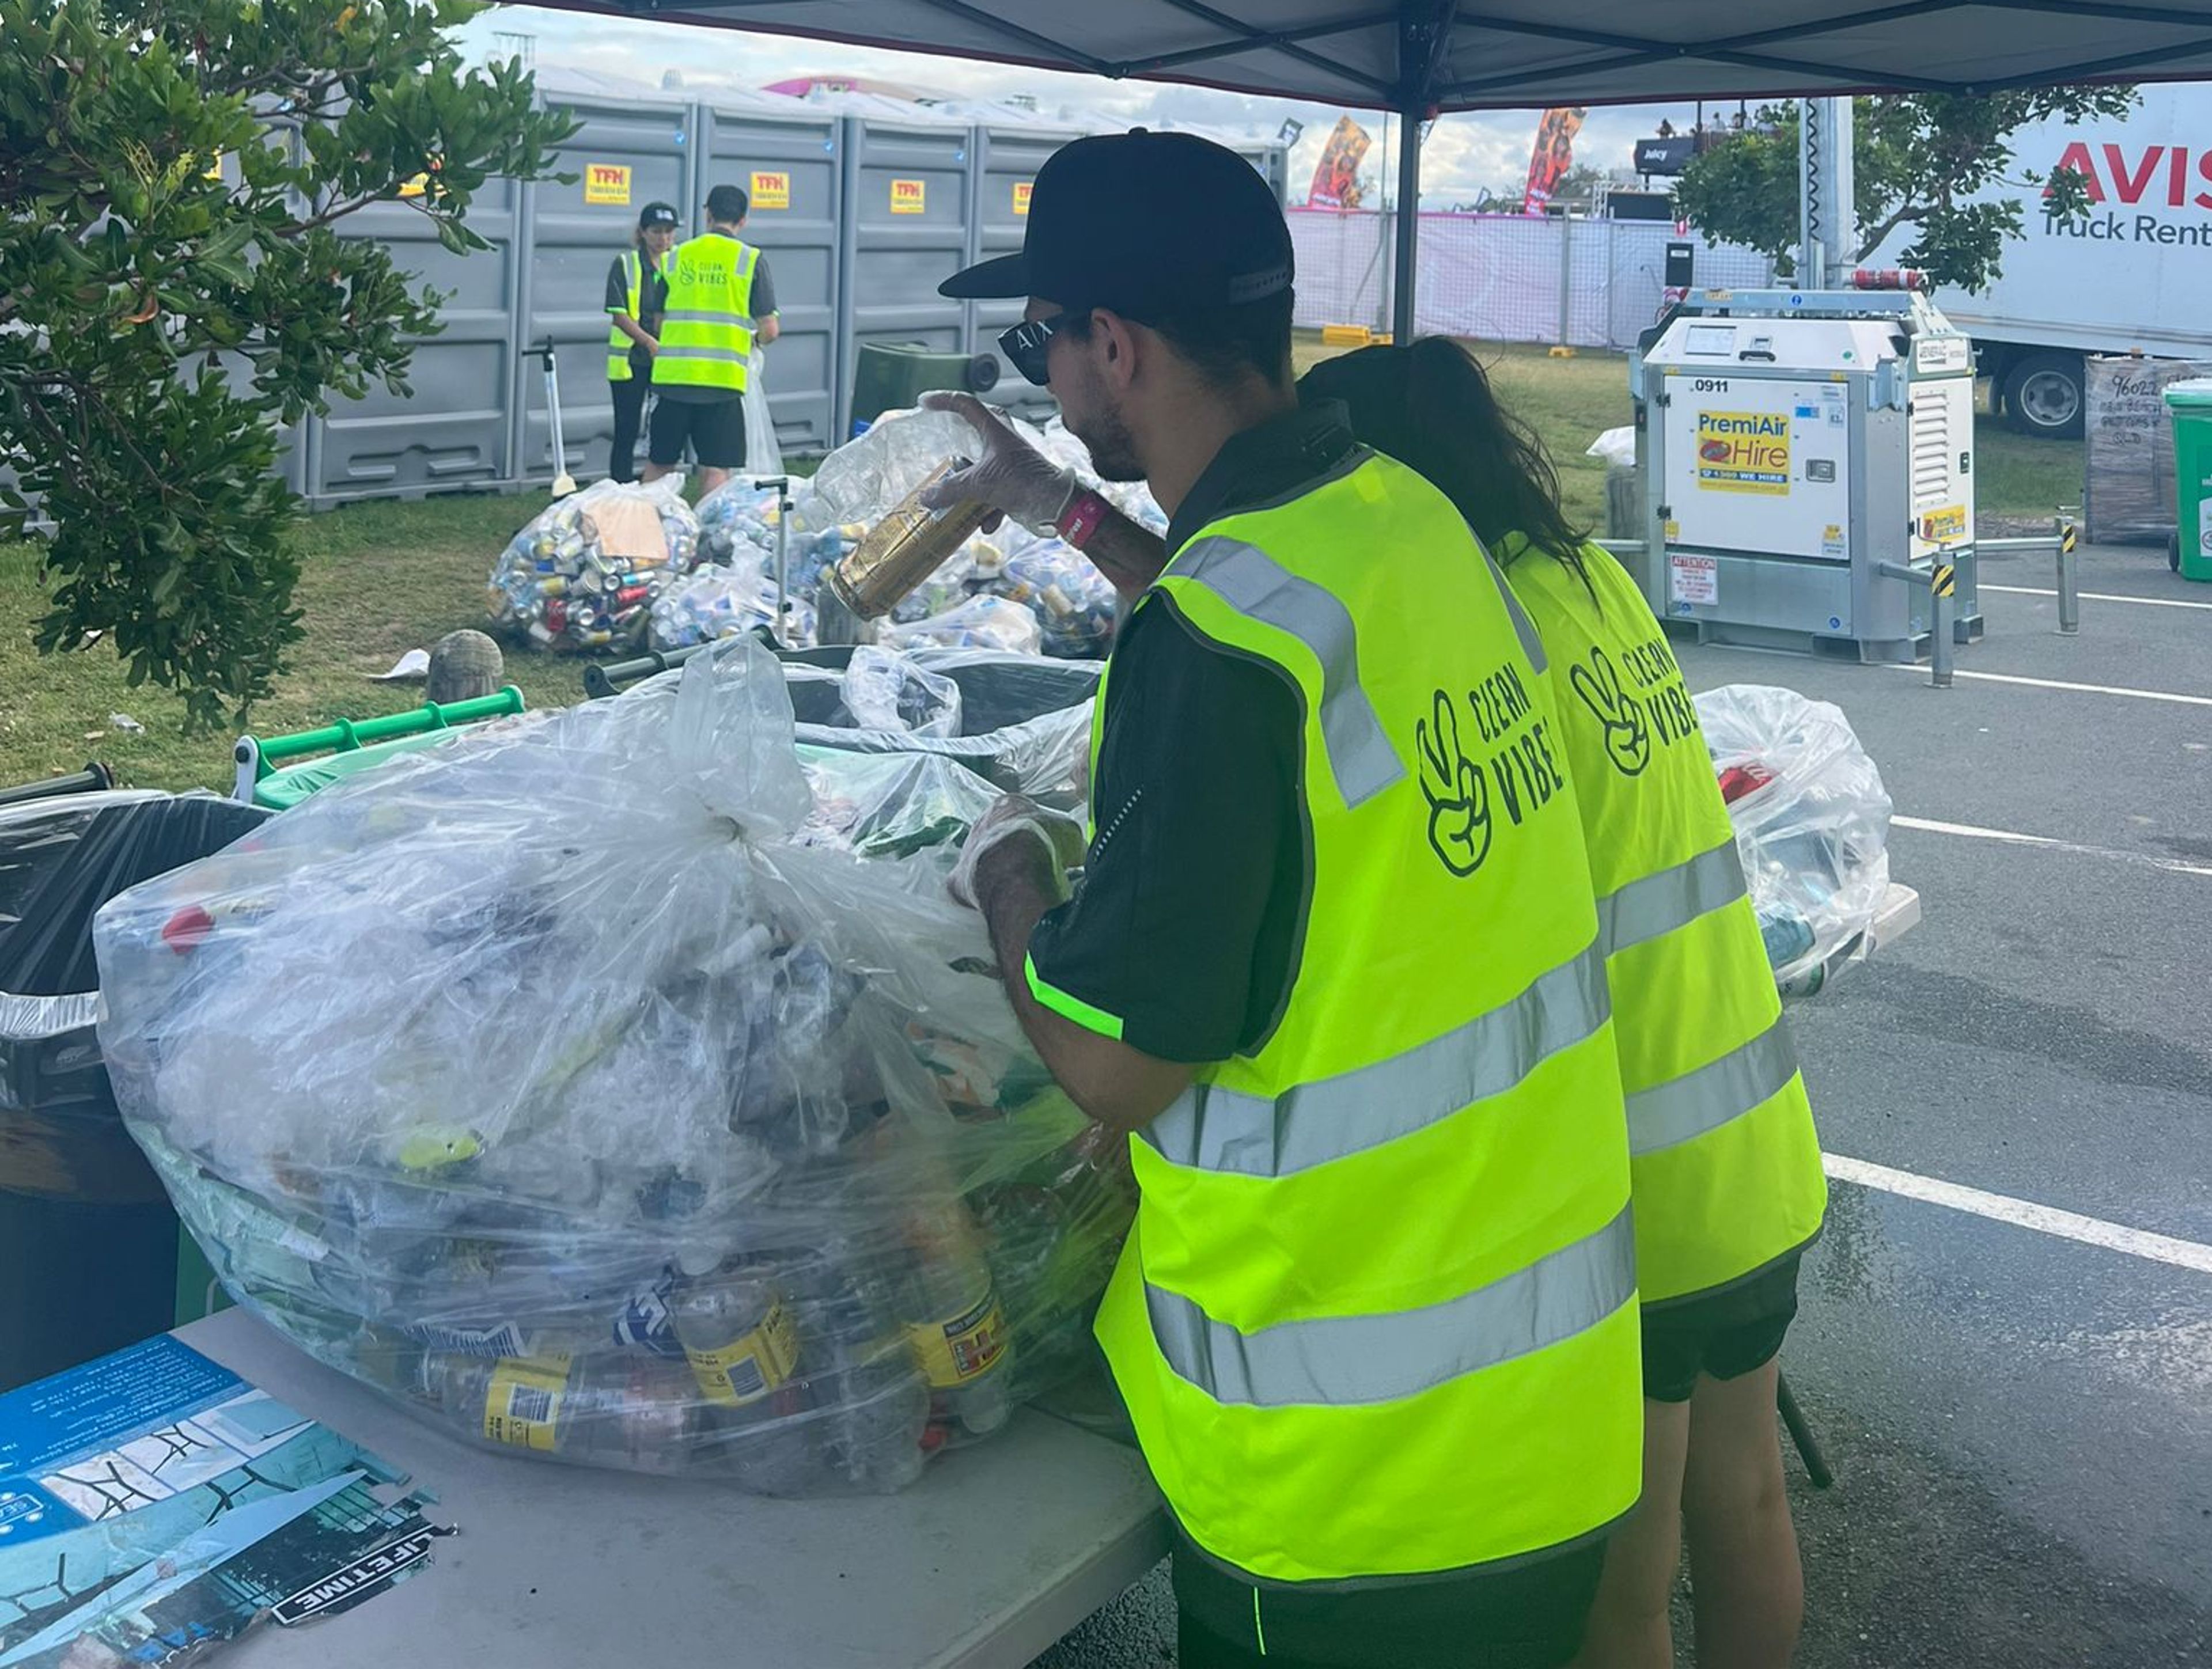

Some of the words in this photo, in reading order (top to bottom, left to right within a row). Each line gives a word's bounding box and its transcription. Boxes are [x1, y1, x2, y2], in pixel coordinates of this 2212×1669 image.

[1695, 379, 1728, 393] 0911
[1699, 414, 1787, 436] PremiAir
[1733, 439, 1787, 468] Hire
[1622, 637, 1677, 688] CLEAN
[1469, 662, 1532, 743] CLEAN
[1646, 681, 1698, 746] VIBE
[1490, 715, 1564, 826] VIBE
[294, 1532, 434, 1611] LIFETIME
